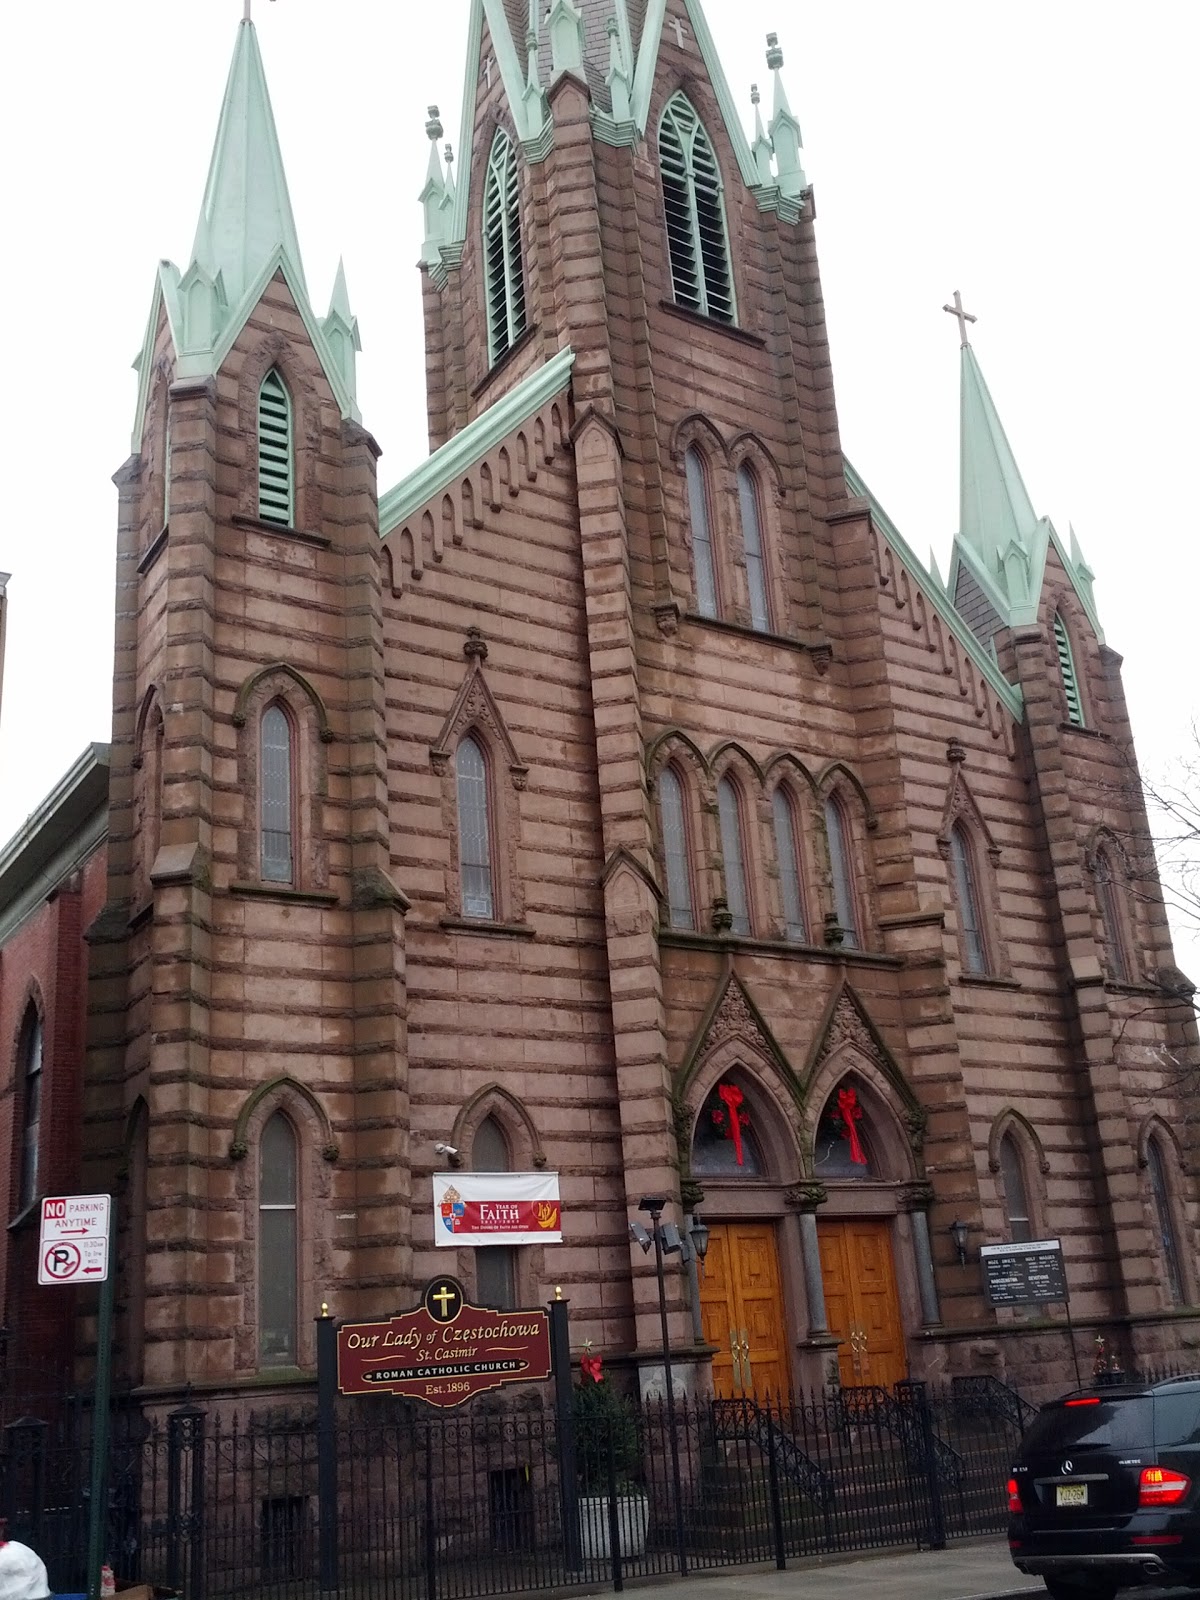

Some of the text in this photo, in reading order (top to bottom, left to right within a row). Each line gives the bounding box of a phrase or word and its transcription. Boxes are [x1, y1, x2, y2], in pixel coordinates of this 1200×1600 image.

[45, 1202, 104, 1218] NO PARKING
[480, 1204, 519, 1220] FAITH
[55, 1218, 97, 1228] ANYTIME
[347, 1320, 540, 1350] Our Lady of Częstochowa
[416, 1346, 478, 1362] St. Casimir
[376, 1361, 516, 1379] ROMAN CATHOLIC CHURCH
